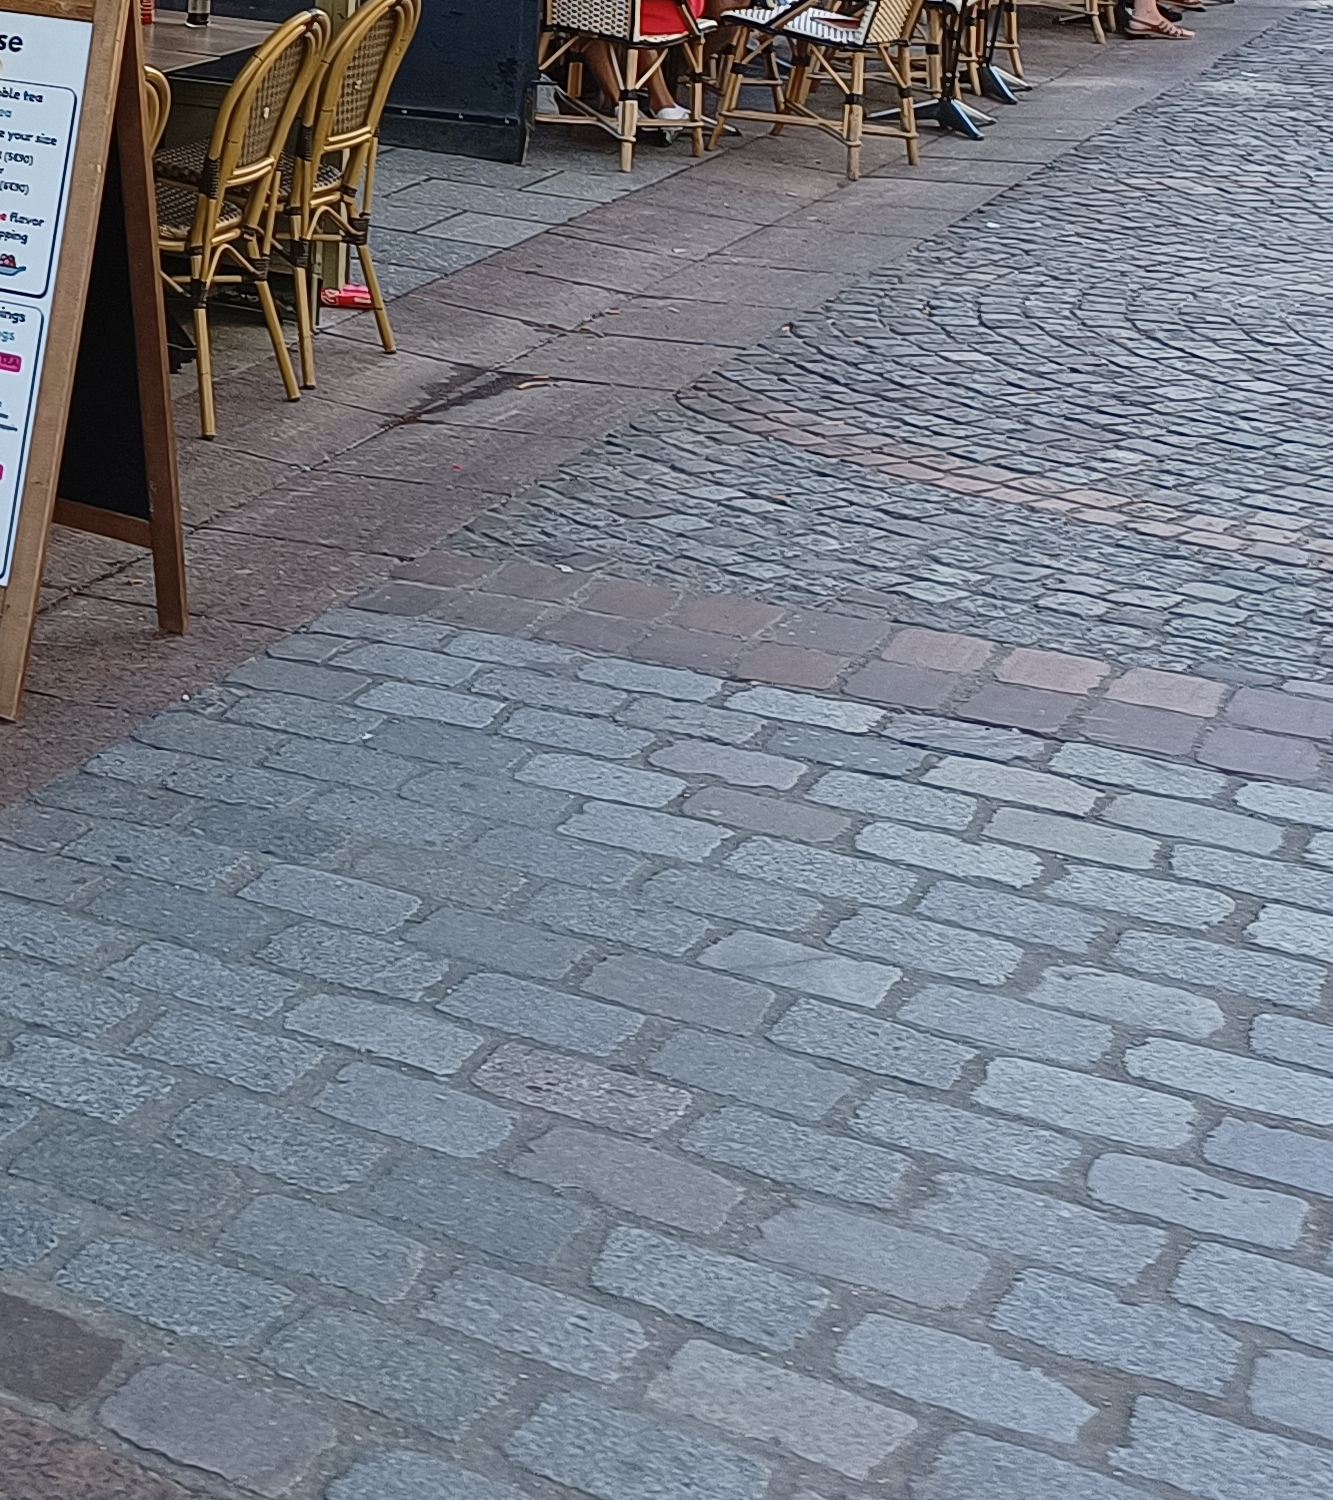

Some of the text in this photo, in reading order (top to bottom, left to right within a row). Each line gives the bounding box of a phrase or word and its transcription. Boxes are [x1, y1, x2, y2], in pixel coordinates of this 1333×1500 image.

[23, 90, 44, 103] tea
[6, 129, 33, 144] your
[9, 211, 45, 228] flavor
